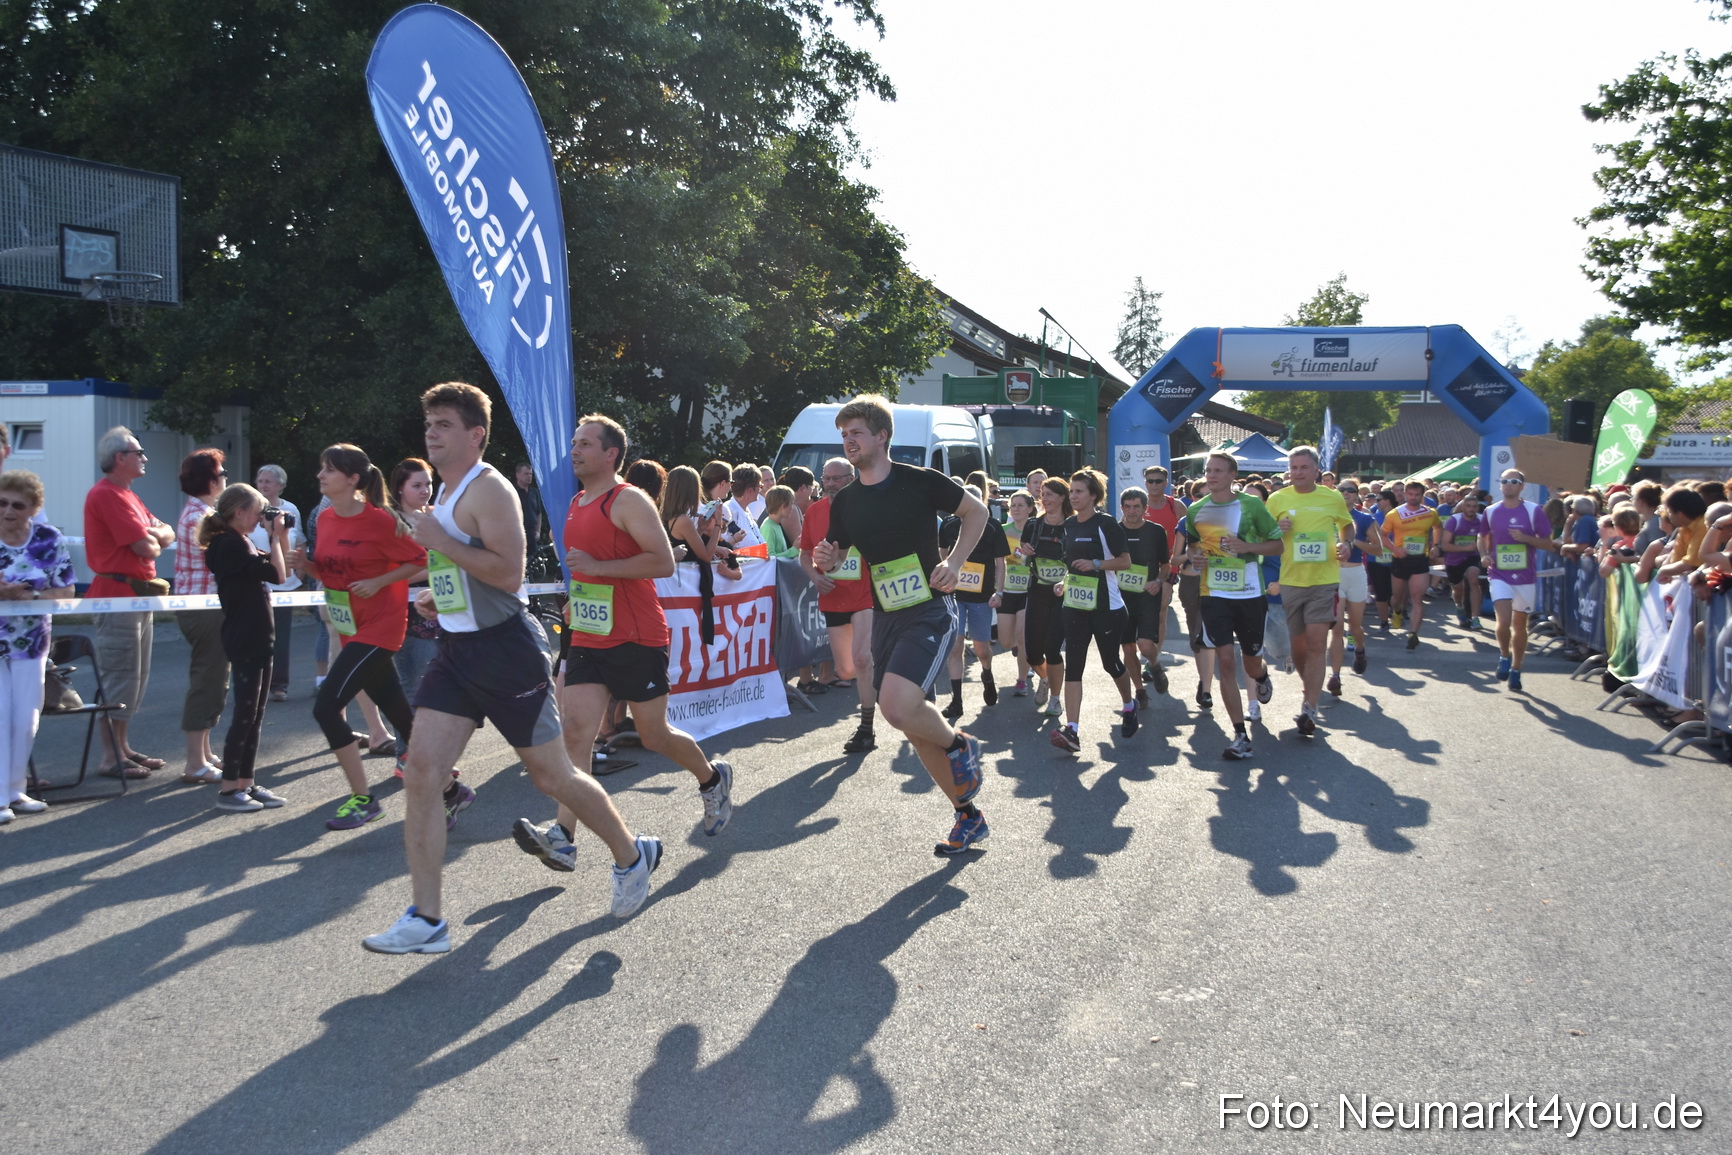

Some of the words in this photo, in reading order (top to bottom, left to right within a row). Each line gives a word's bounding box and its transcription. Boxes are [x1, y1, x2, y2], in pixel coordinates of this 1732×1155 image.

[1300, 358, 1379, 372] firmenlauf
[1155, 383, 1196, 394] Fischer
[1622, 424, 1646, 450] AOK
[1664, 437, 1697, 447] Jura
[1597, 443, 1624, 472] AOK
[1299, 544, 1321, 555] 642
[1502, 555, 1521, 563] 502
[1040, 567, 1066, 578] 1222
[1119, 572, 1144, 586] 1251
[1214, 570, 1238, 582] 998
[433, 574, 455, 597] 605
[880, 574, 922, 598] 1172
[1009, 575, 1028, 585] 989
[1067, 587, 1094, 601] 1094
[328, 606, 351, 624] 1524
[573, 601, 608, 621] 1365
